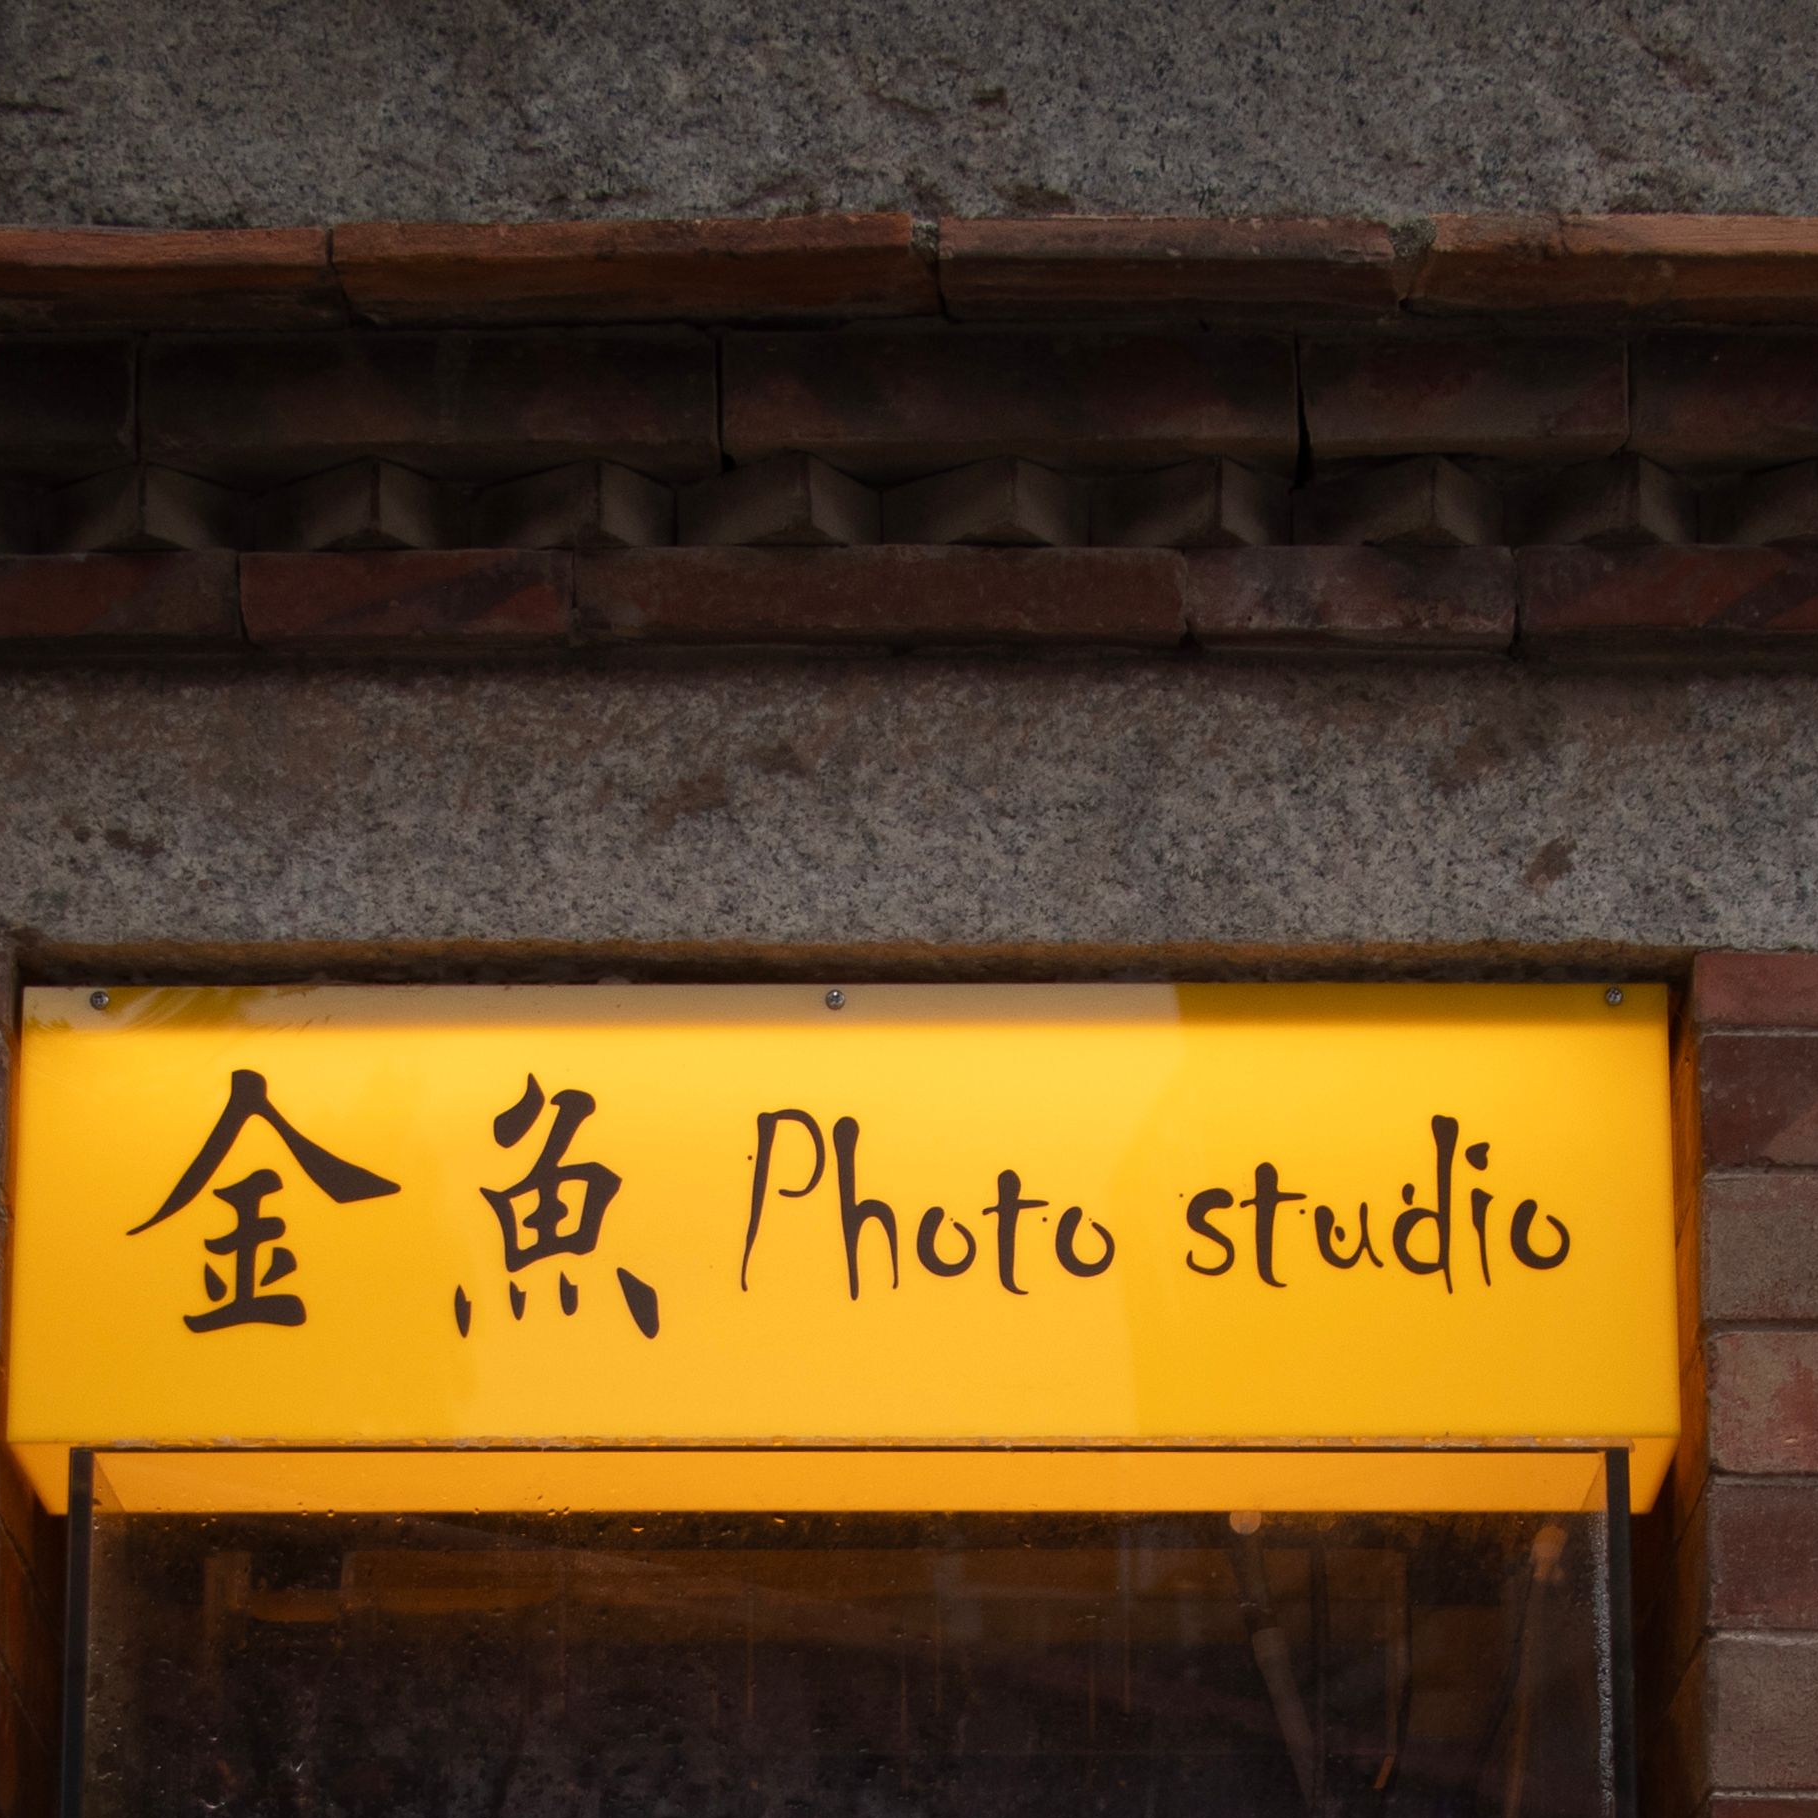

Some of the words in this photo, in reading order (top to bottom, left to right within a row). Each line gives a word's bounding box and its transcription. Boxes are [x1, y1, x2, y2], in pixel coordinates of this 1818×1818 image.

[124, 1068, 662, 1341] 金魚
[740, 1107, 1117, 1302] Photo
[1184, 1113, 1573, 1296] studio
